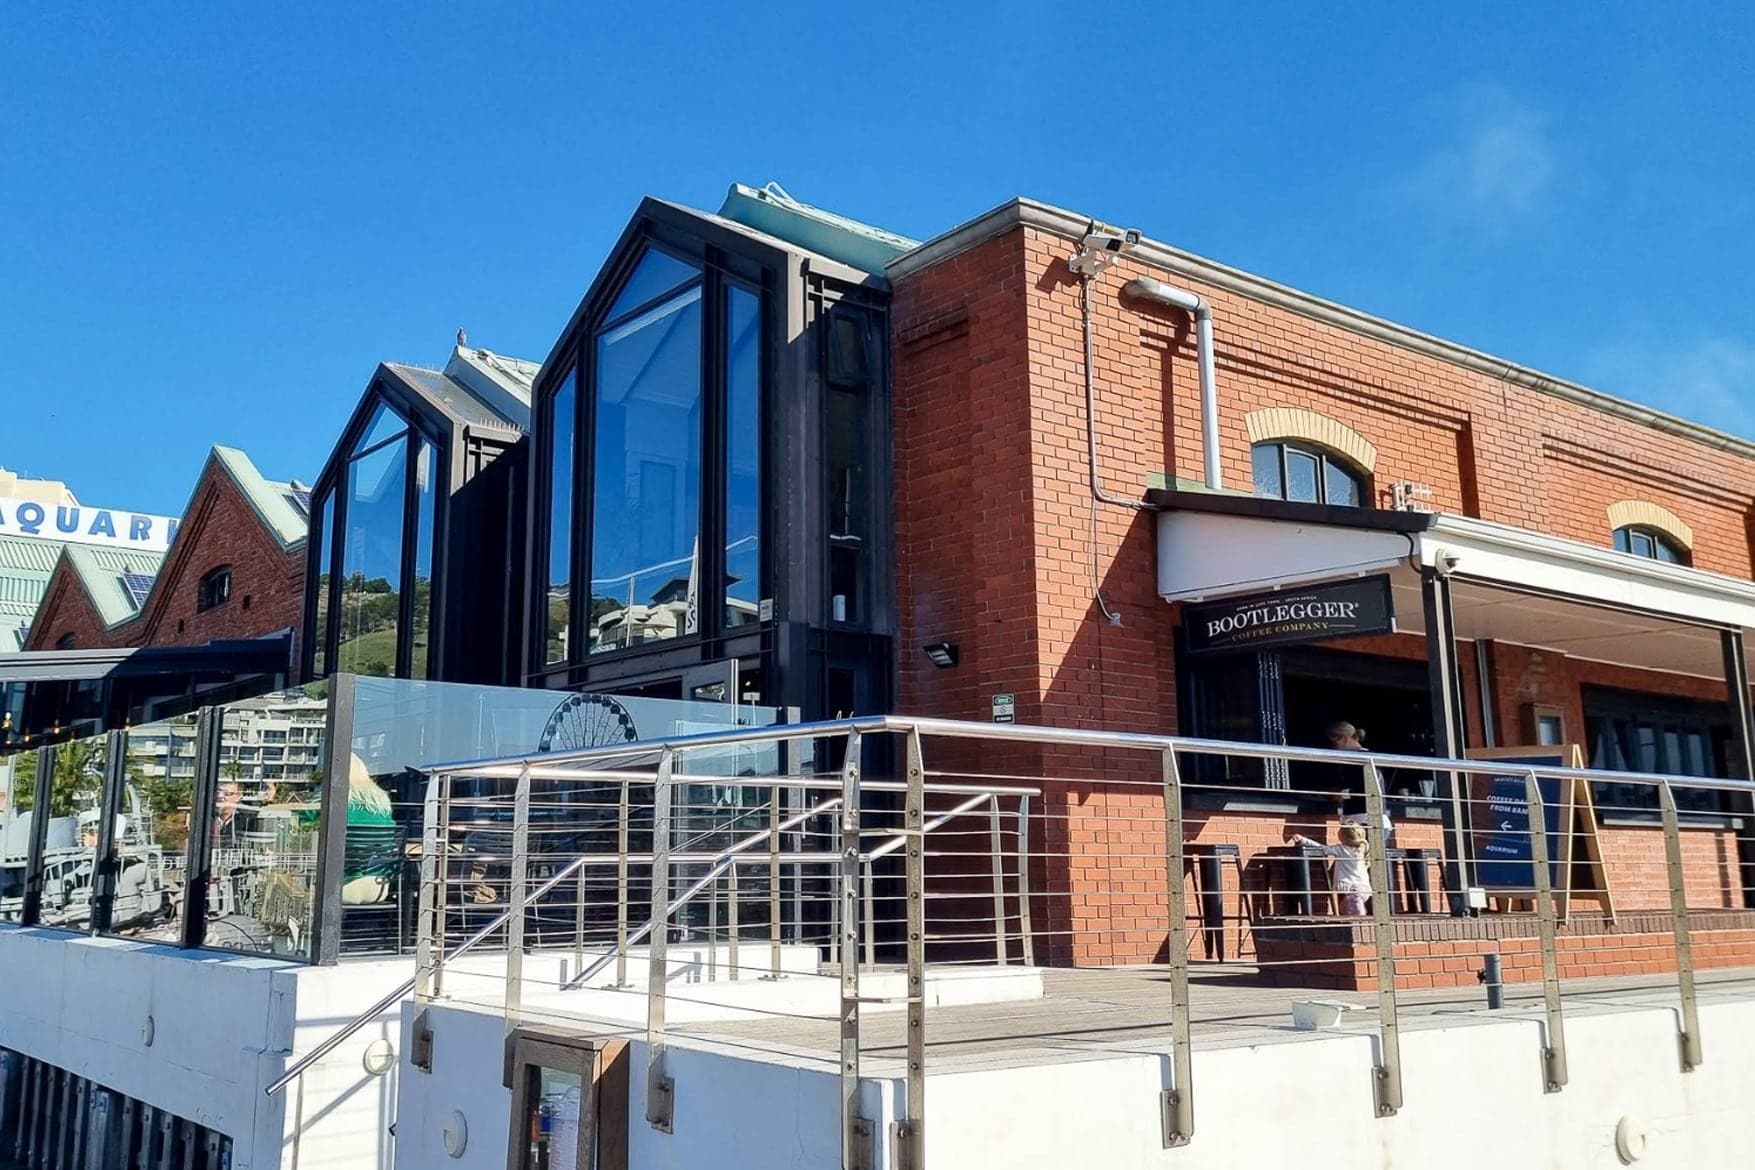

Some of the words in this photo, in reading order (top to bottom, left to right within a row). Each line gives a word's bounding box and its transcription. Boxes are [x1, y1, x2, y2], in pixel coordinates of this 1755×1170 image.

[1207, 602, 1356, 637] BOOTLEGGER
[1232, 627, 1272, 641] COFFEE
[1275, 621, 1328, 633] COMPANY
